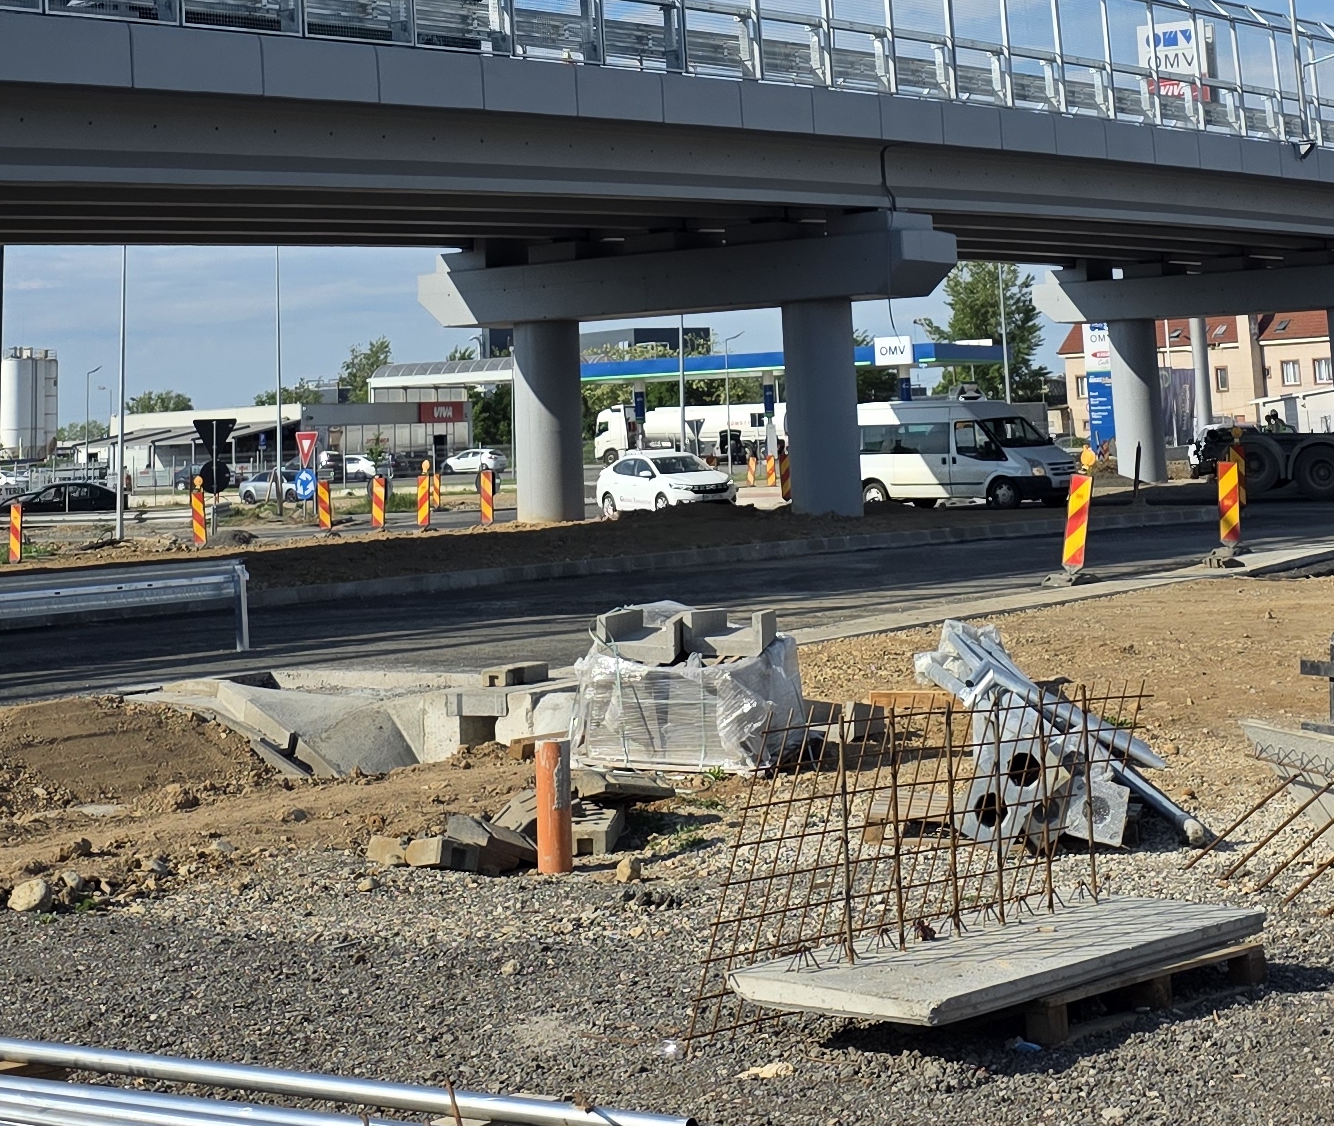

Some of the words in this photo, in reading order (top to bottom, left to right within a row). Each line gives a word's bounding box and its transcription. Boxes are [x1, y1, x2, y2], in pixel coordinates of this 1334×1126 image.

[1148, 52, 1195, 70] OMV
[880, 345, 906, 356] OMV
[433, 406, 453, 418] VIVA
